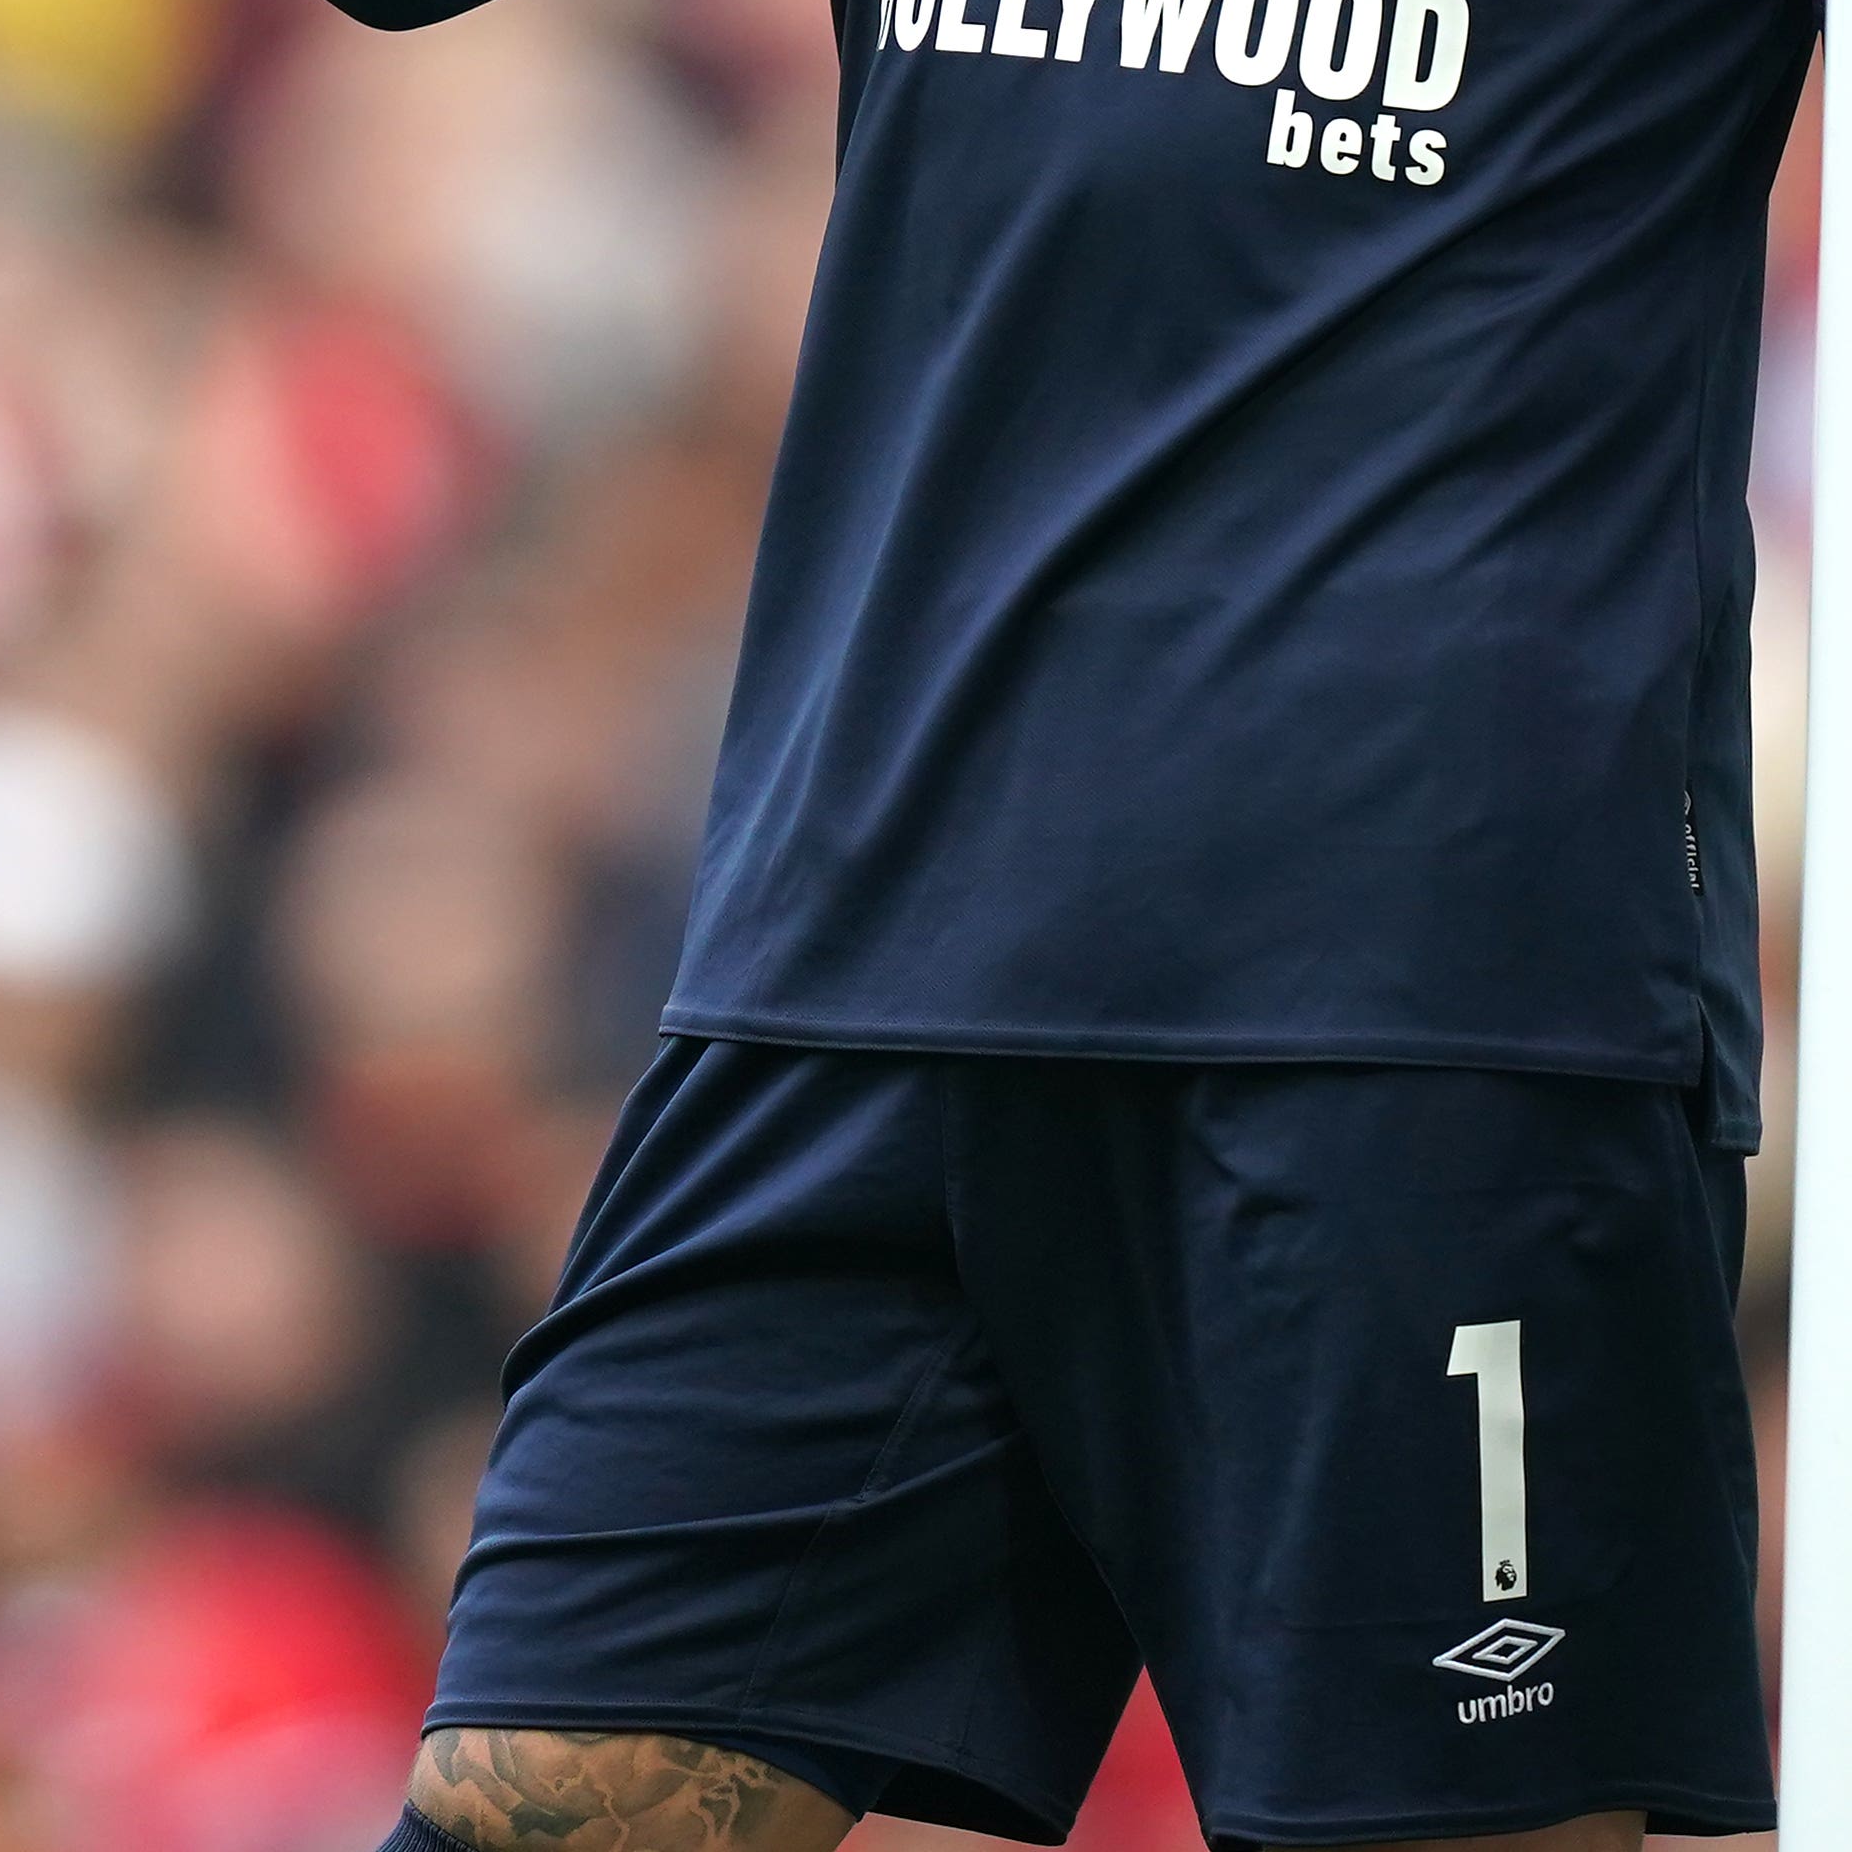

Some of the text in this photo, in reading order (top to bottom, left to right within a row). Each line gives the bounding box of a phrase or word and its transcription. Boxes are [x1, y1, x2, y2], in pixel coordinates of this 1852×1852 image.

[1266, 88, 1448, 186] bets
[1446, 1319, 1528, 1602] 1
[1457, 1682, 1555, 1725] umbro
